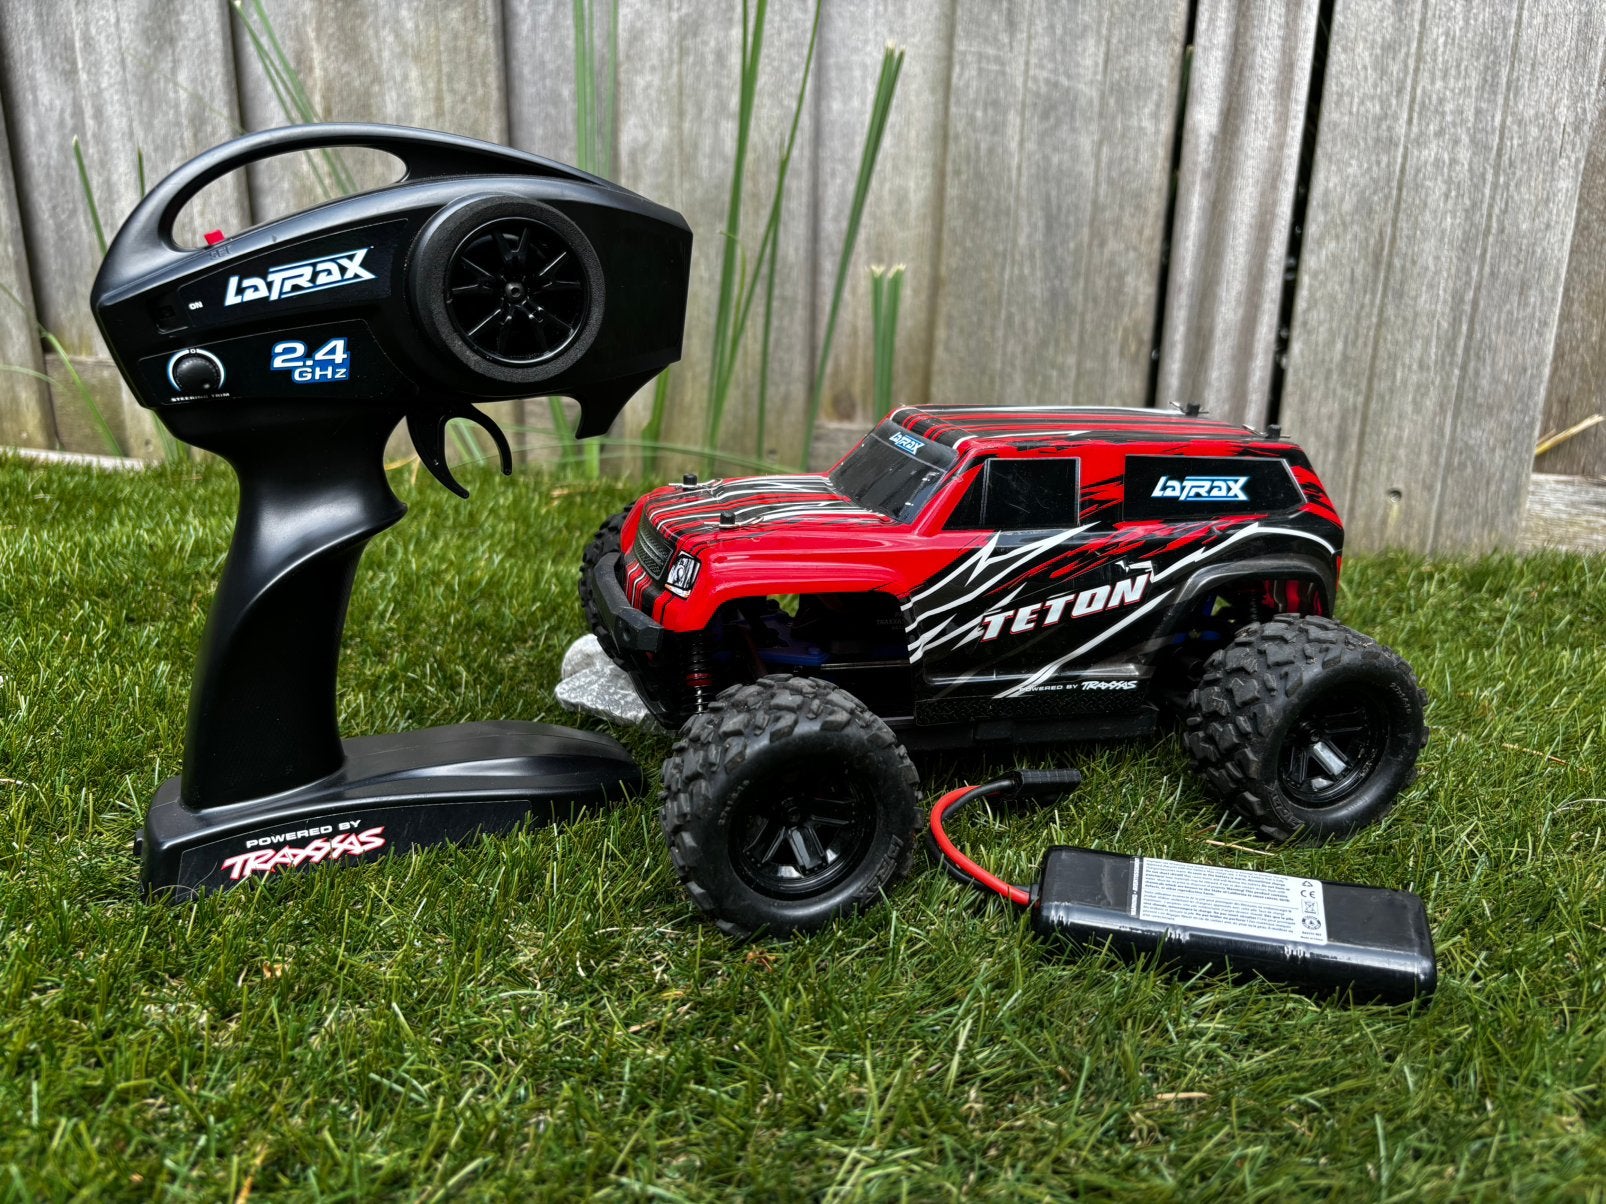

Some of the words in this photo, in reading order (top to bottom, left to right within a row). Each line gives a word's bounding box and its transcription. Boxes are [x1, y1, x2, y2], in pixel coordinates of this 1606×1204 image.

[189, 301, 203, 310] ON
[273, 340, 347, 368] 2.4
[980, 573, 1151, 642] TETON
[1020, 684, 1063, 692] POWERED
[1081, 680, 1138, 690] TRAXXAS
[245, 825, 333, 848] POWERED
[338, 819, 361, 831] BY
[221, 826, 385, 880] TRAXXAS
